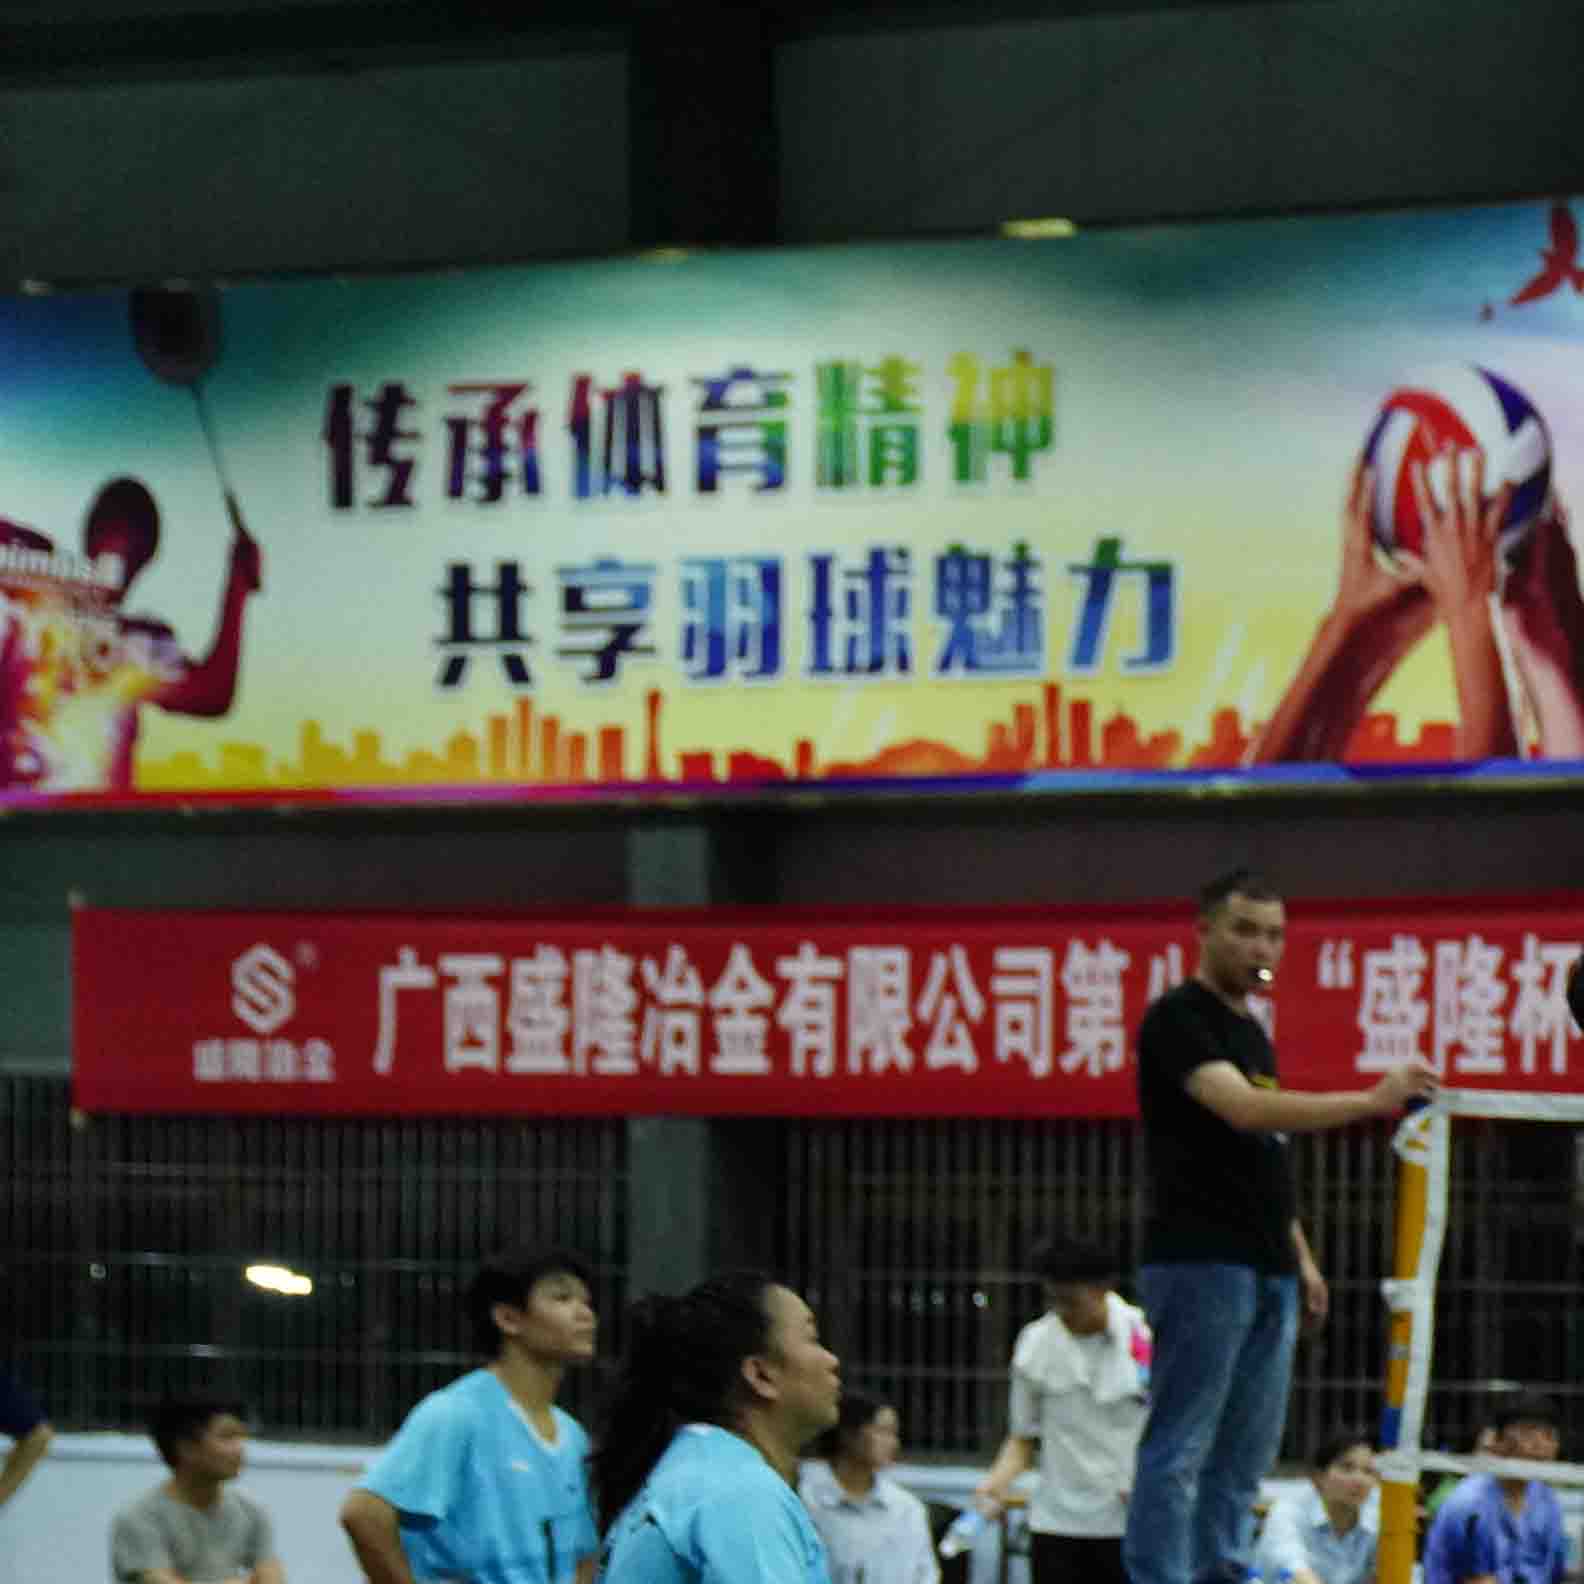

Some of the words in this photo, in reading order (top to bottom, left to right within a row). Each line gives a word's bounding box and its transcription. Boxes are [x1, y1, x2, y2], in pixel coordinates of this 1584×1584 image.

[323, 347, 1056, 511] 传承体育精神
[434, 537, 1177, 687] 共享羽球魅力
